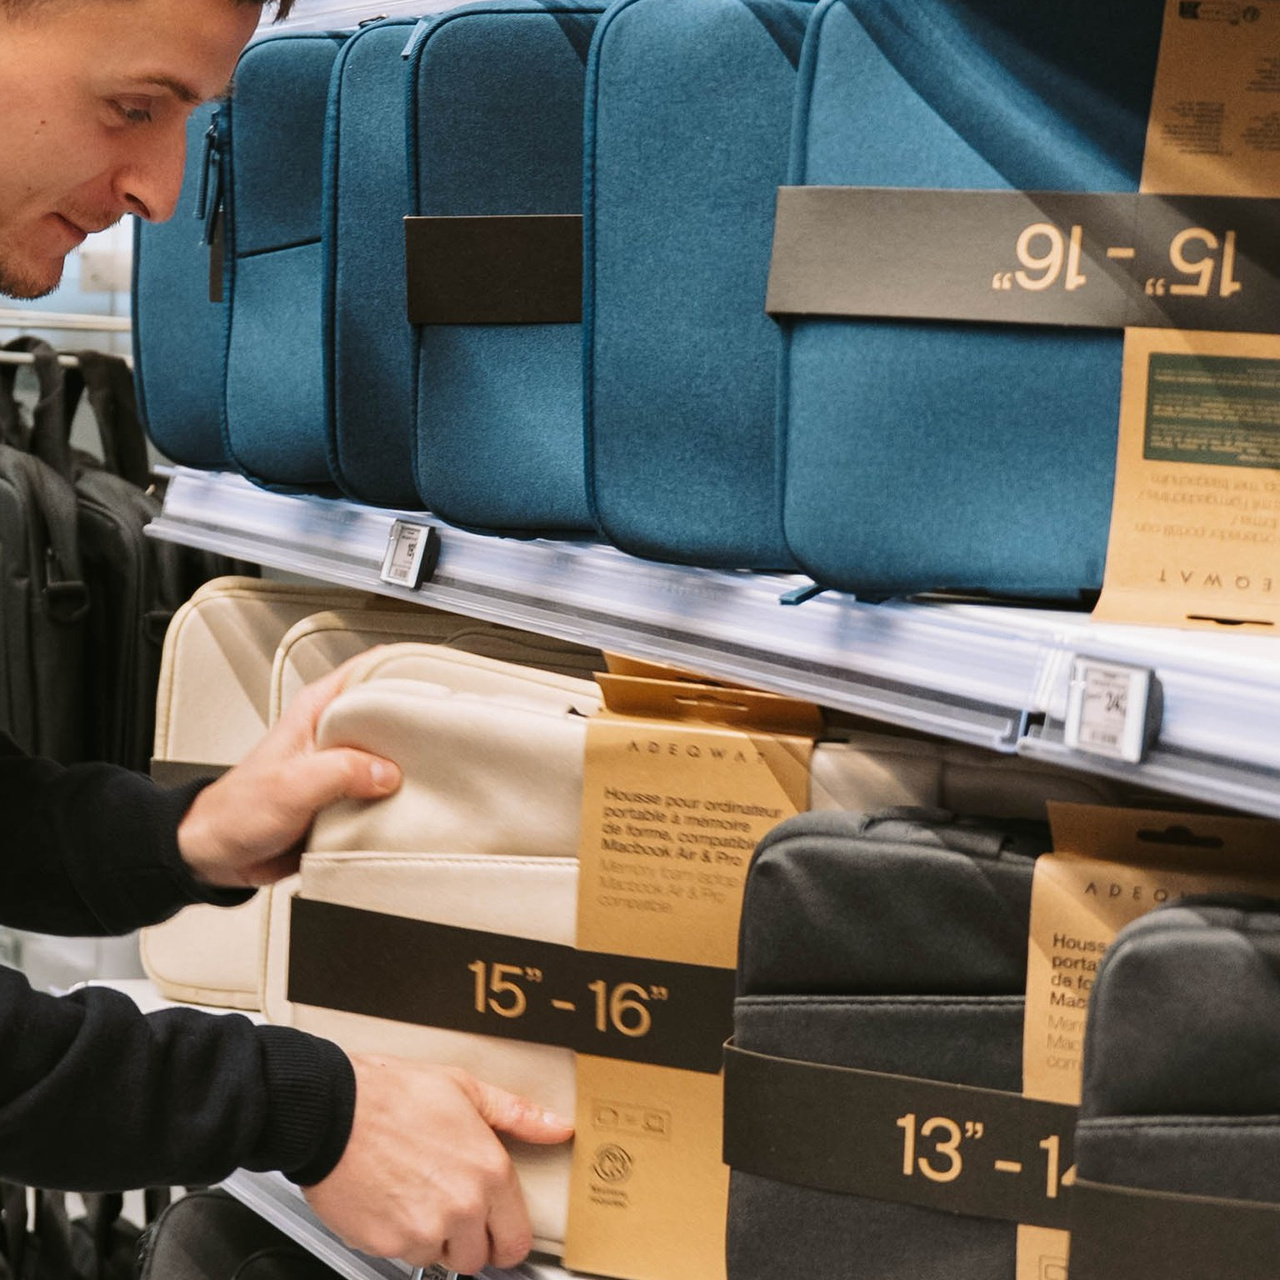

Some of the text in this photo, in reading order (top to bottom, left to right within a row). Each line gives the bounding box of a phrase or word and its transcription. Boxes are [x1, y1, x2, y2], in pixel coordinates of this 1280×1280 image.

[604, 787, 783, 819] Housse pour ordinateur
[603, 806, 667, 824] portable
[602, 821, 621, 836] de
[601, 838, 670, 858] Macbook
[1084, 881, 1189, 903] ADEQ
[1052, 933, 1107, 954] Houss
[1051, 954, 1097, 973] porta
[468, 959, 543, 1018] 15”
[587, 979, 669, 1038] 16”
[896, 1113, 984, 1183] 13”
